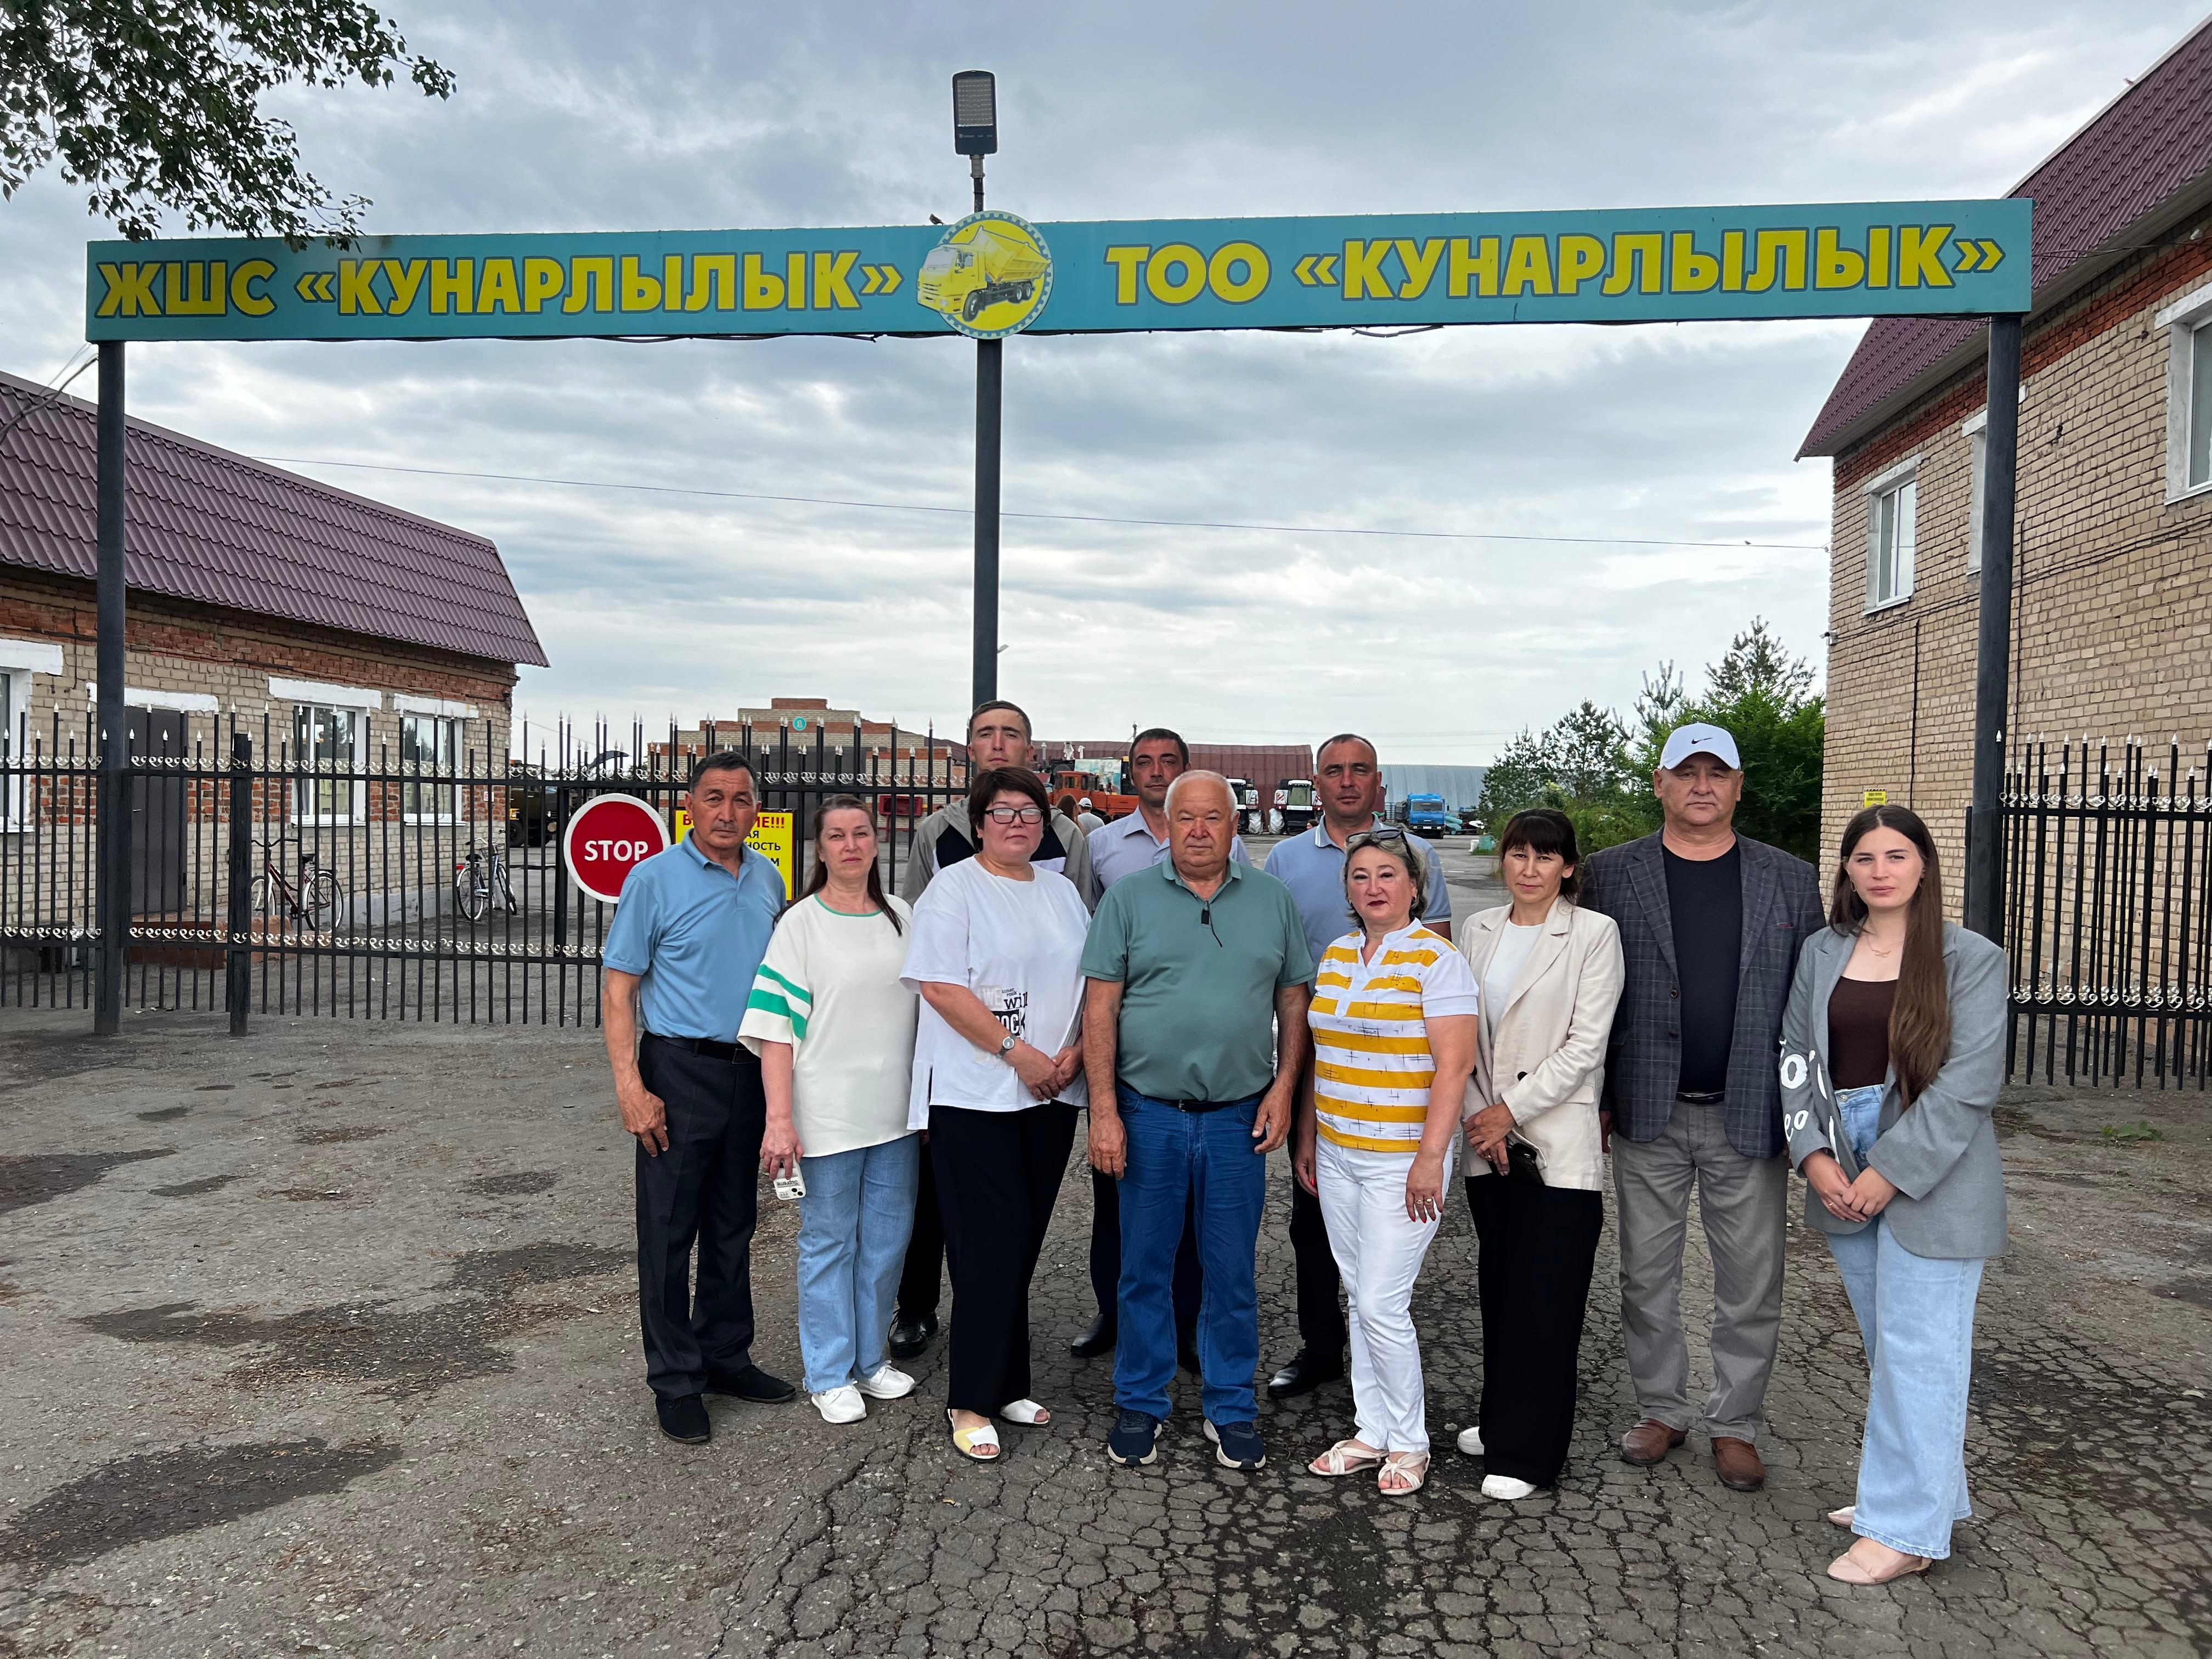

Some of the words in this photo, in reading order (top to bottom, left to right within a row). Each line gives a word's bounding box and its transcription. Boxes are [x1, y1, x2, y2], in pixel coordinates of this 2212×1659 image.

[96, 259, 276, 317] ЖШС
[296, 251, 902, 315] «КУНАРЛЫЛЫК»
[1105, 241, 1271, 305] ТОО
[1294, 225, 2004, 300] «КУНАРЛЫЛЫК»
[584, 840, 648, 861] STOP
[995, 1013, 1025, 1036] OCK
